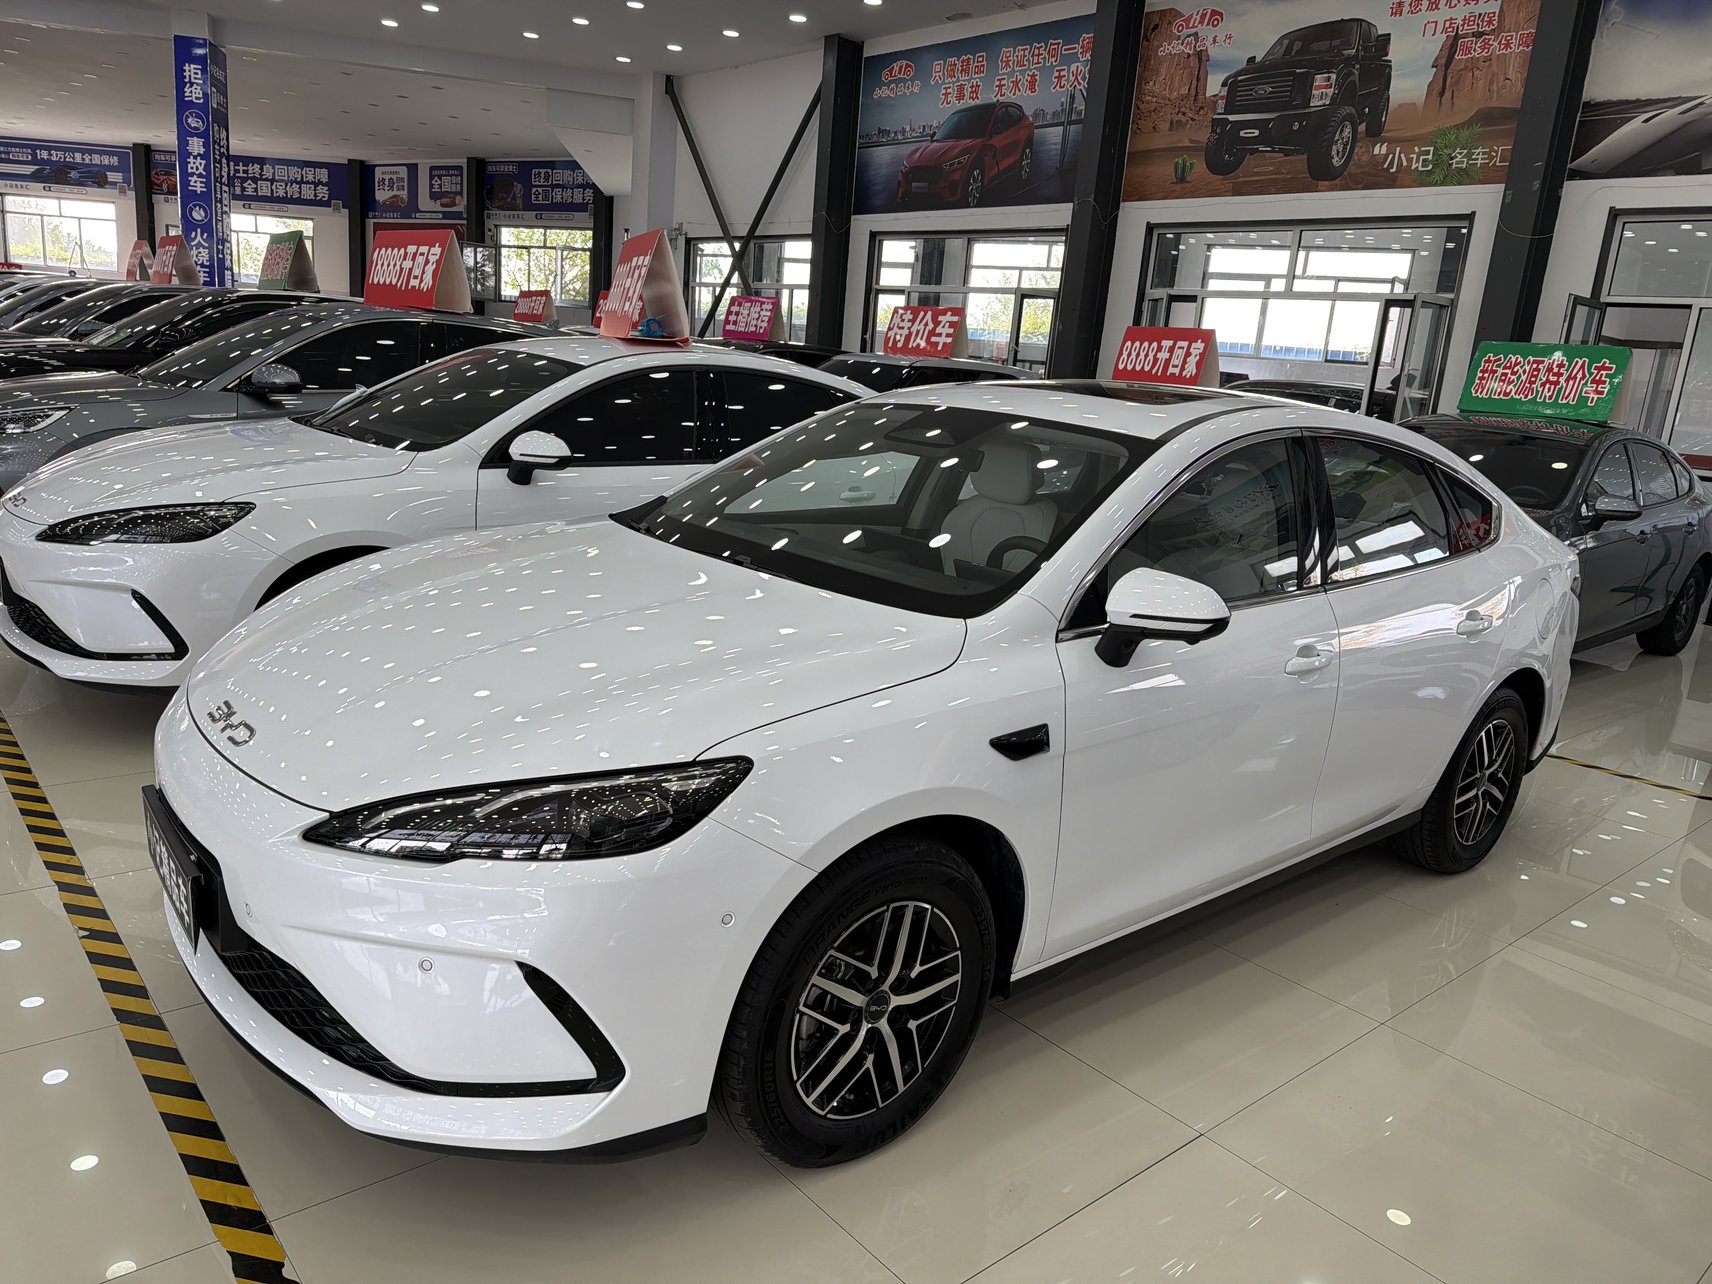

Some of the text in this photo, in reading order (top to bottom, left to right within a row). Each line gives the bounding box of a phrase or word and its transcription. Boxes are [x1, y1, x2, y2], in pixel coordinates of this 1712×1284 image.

[1389, 0, 1498, 18] 请您放心
[1422, 11, 1498, 38] 门店担保
[931, 33, 1095, 85] 只做精品 保证任何一辆
[1456, 29, 1536, 59] 服务保障
[940, 64, 1092, 108] 无事故 无水淹 无火
[1449, 145, 1513, 169] 名车汇
[183, 63, 210, 287] 拒绝 事故车 火烧车
[242, 180, 330, 201] 全国保修服务
[377, 177, 396, 192] 终身
[432, 176, 451, 192] 全国
[369, 242, 442, 292] 18888开回家
[725, 301, 773, 334] 主播推荐
[887, 310, 960, 351] 特价车
[1118, 339, 1205, 379] 8888开回家
[1471, 353, 1617, 406] 新能源特价车
